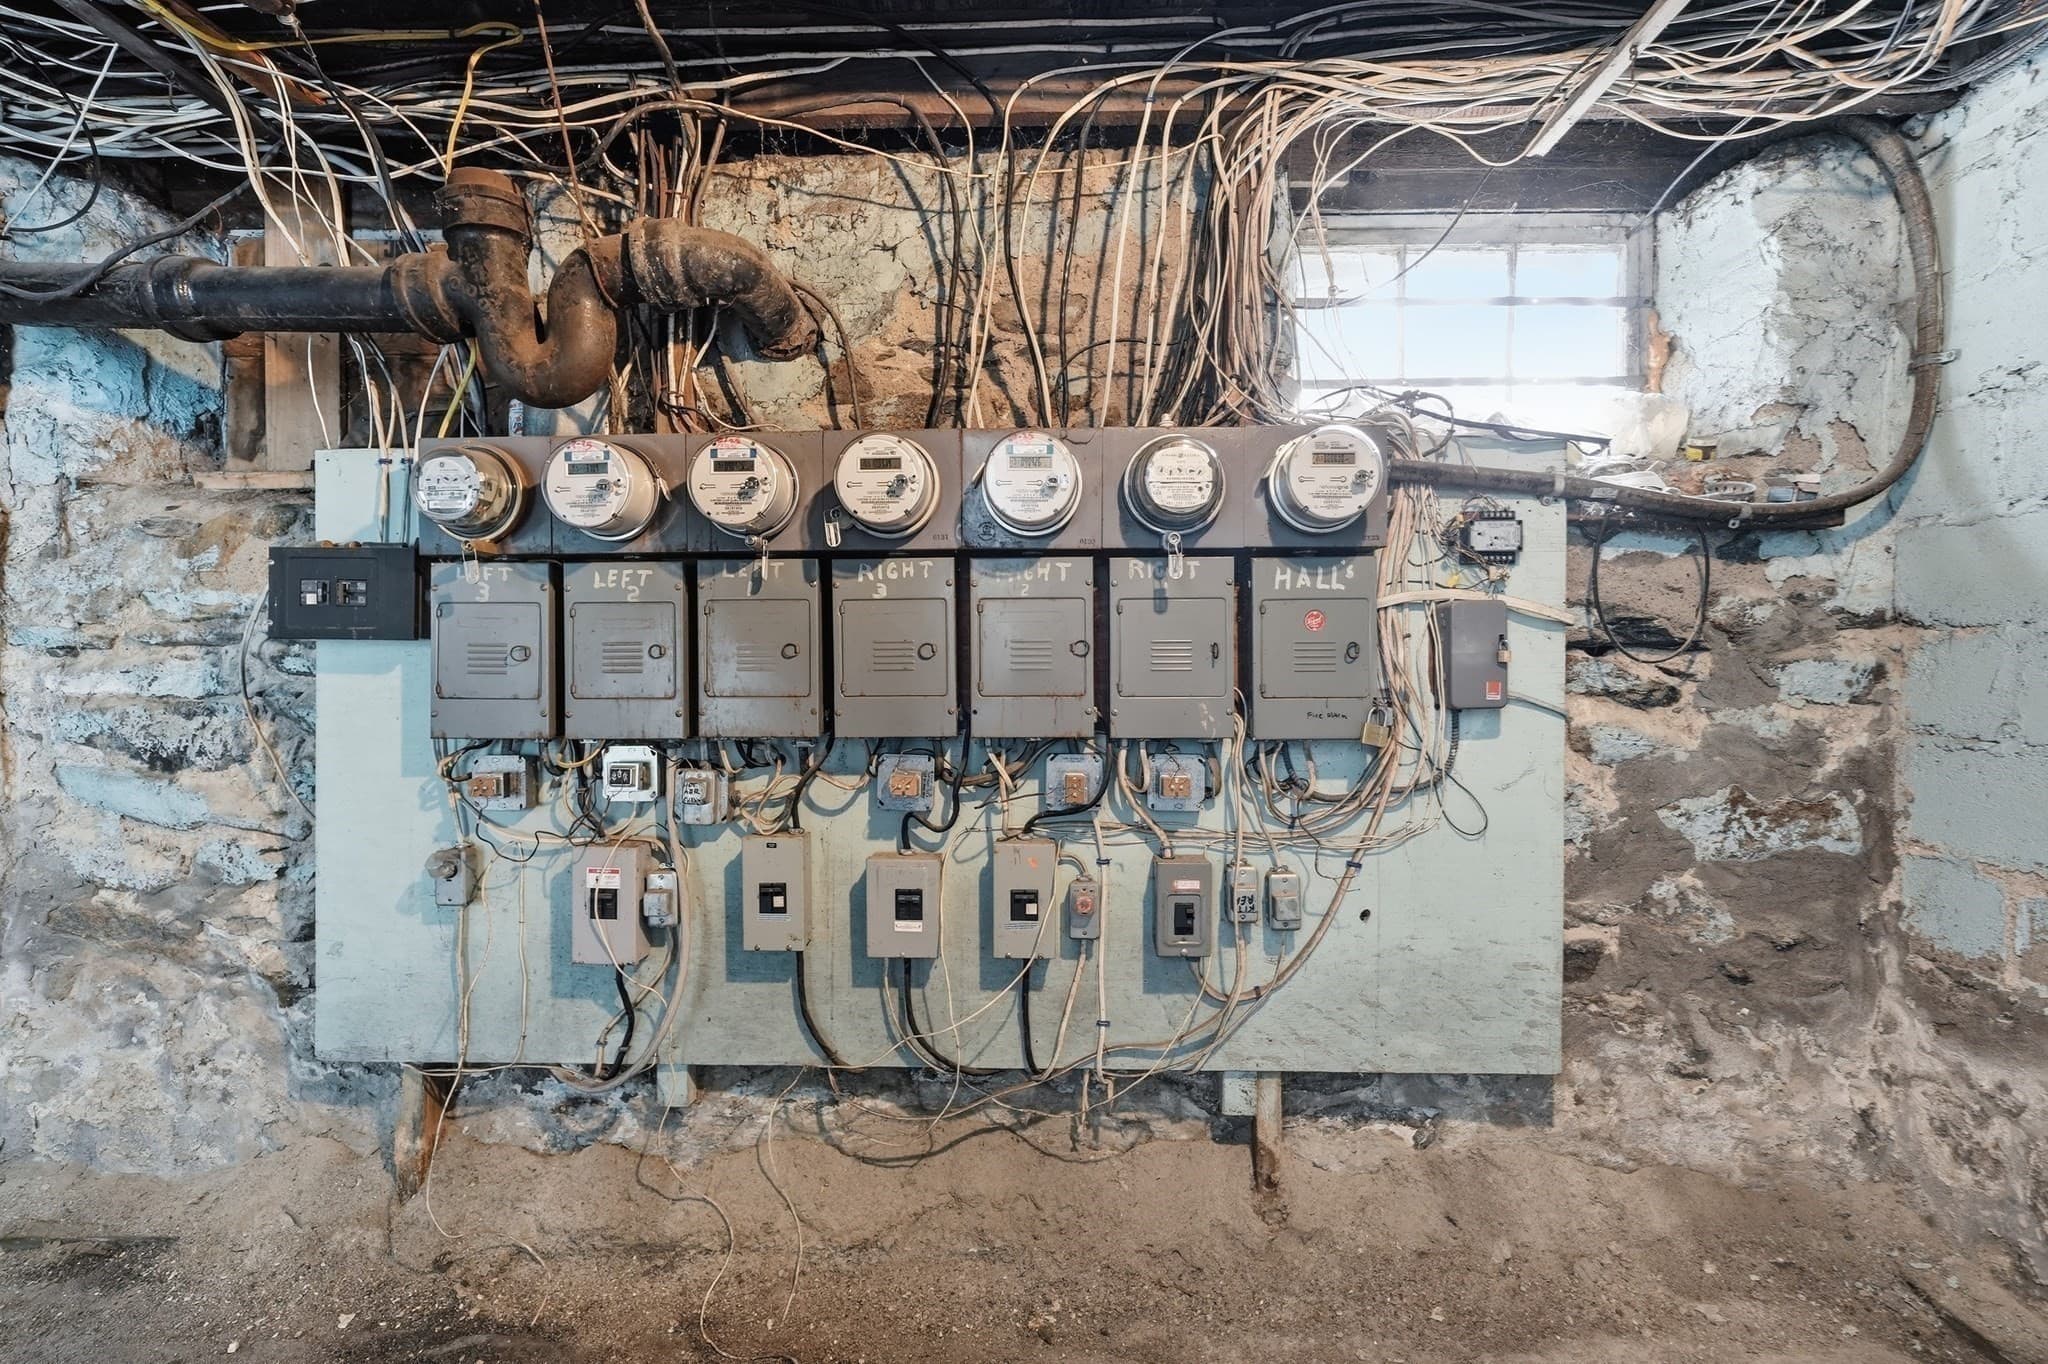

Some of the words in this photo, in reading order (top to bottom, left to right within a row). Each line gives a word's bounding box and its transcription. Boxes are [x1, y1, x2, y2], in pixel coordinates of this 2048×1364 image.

[456, 565, 513, 582] LFT
[593, 568, 654, 590] LEFT
[858, 560, 934, 582] RIGHT
[1128, 559, 1201, 580] RIGT
[475, 581, 490, 602] 3
[626, 585, 640, 601] 2
[872, 582, 887, 599] 3
[1021, 583, 1030, 596] 2
